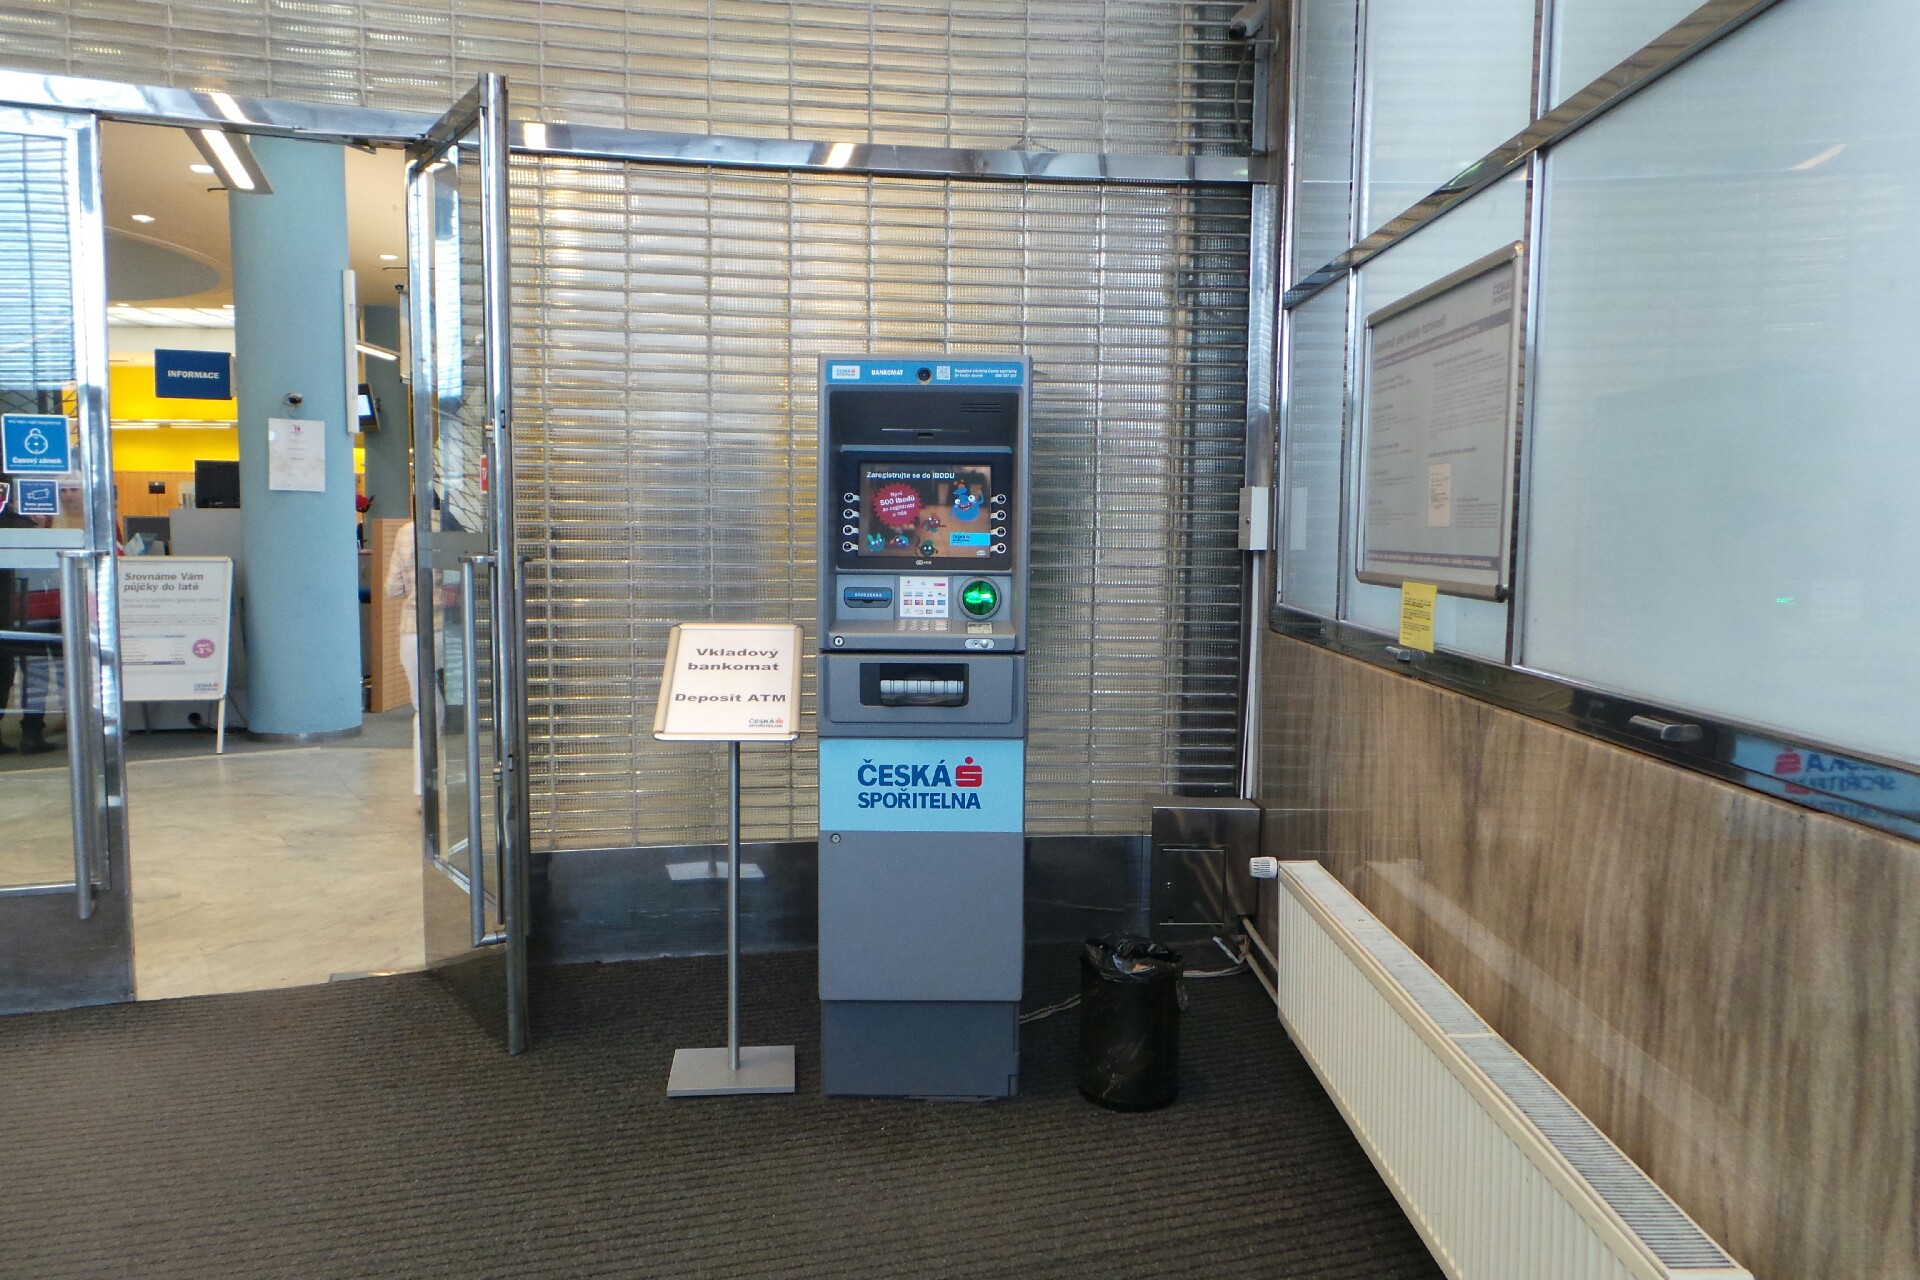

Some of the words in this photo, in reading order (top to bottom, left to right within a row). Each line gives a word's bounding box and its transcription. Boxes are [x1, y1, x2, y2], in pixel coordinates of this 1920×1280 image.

[167, 370, 220, 380] INFORMACE
[866, 471, 911, 479] Zaregistrujte
[922, 471, 930, 479] do
[880, 498, 894, 506] 500
[124, 571, 178, 581] Srovnáme
[180, 572, 204, 581] Vám
[123, 583, 160, 592] půjčky
[161, 583, 176, 591] do
[696, 648, 779, 659] Vkladový
[687, 662, 780, 671] bankomat
[674, 693, 742, 704] Deposit
[747, 693, 786, 702] ATM
[857, 758, 952, 787] ČESKÁ
[857, 788, 982, 810] SPOŘITELNA
